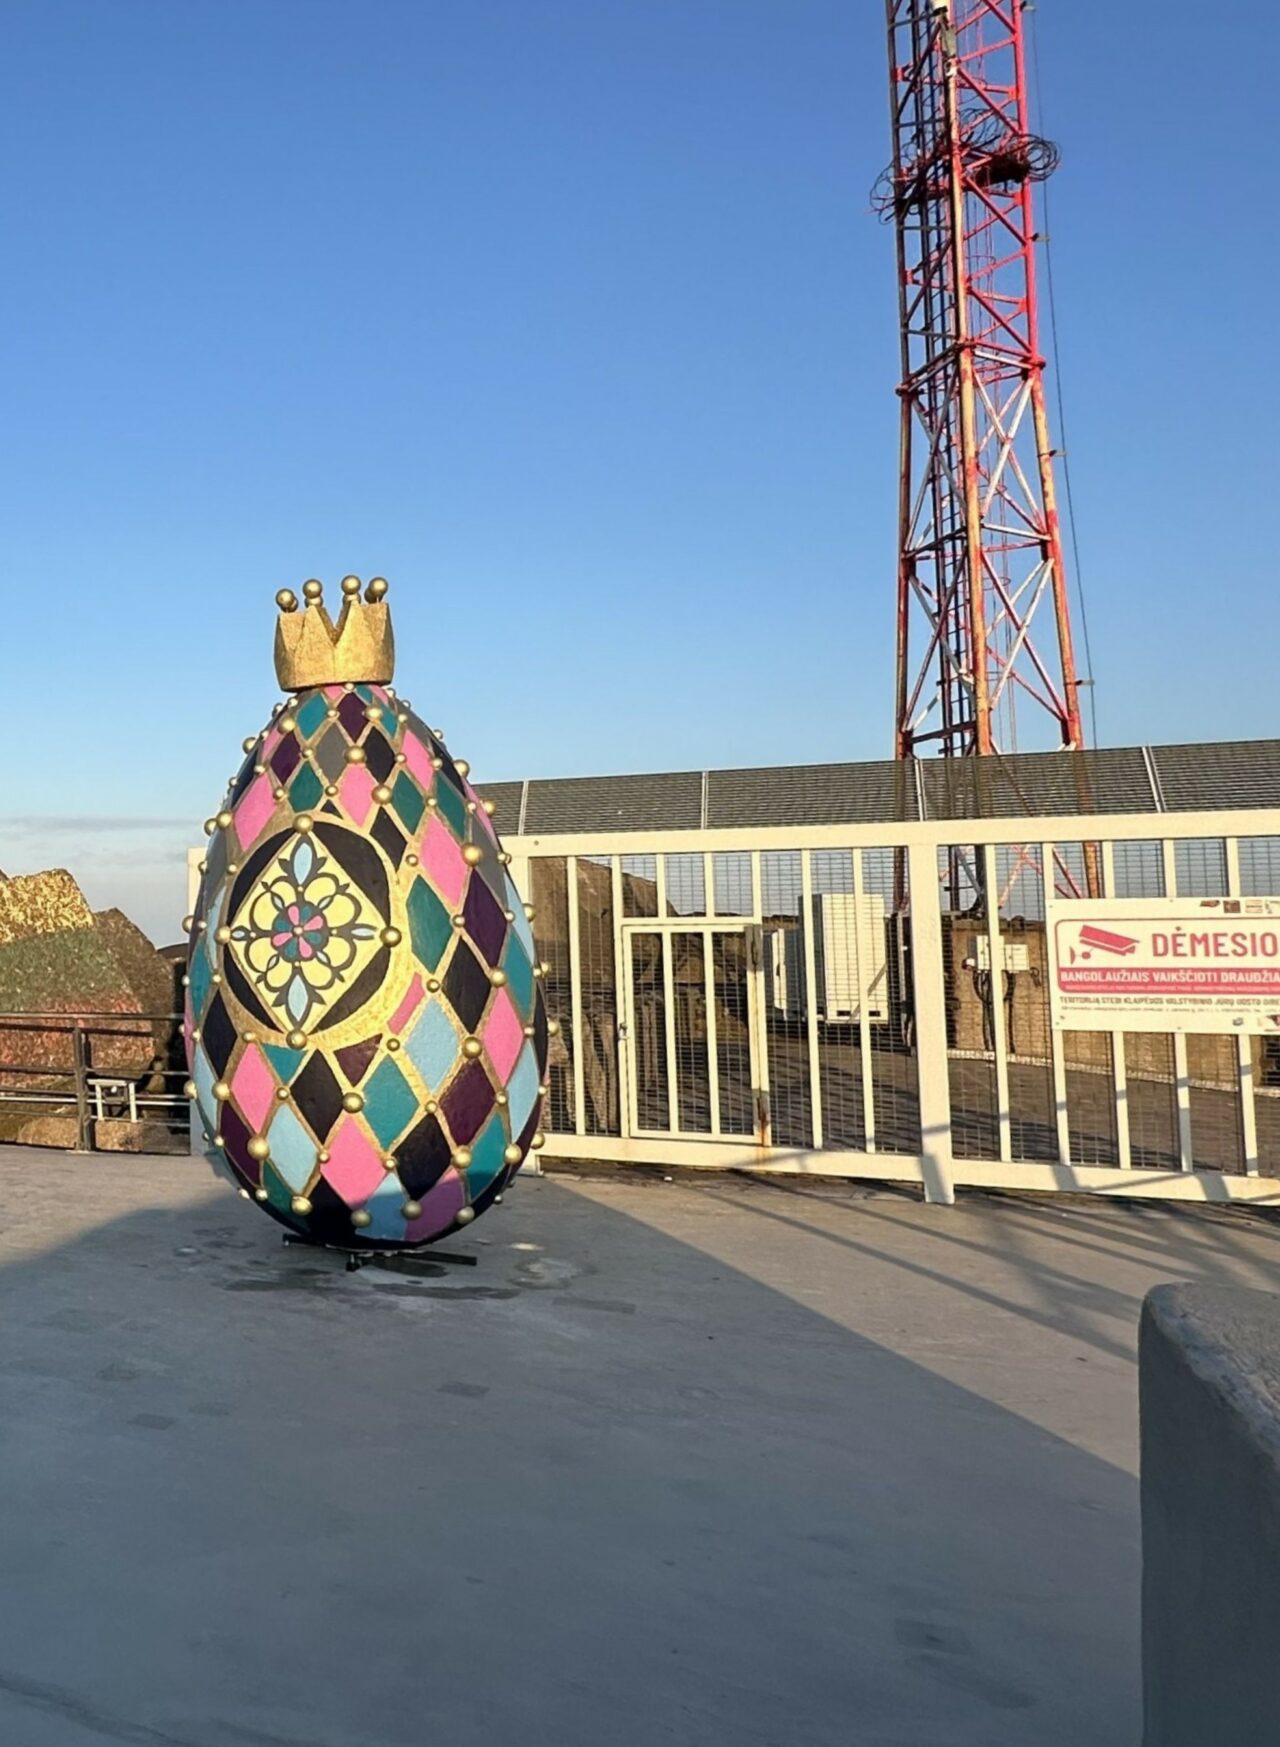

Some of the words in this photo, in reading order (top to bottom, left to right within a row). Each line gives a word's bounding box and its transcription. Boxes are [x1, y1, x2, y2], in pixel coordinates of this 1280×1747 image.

[1151, 926, 1279, 957] DĖMESIO
[1060, 969, 1150, 983] BANGOLAUŽIAIS
[1152, 969, 1218, 983] VAIKŠČIOTI
